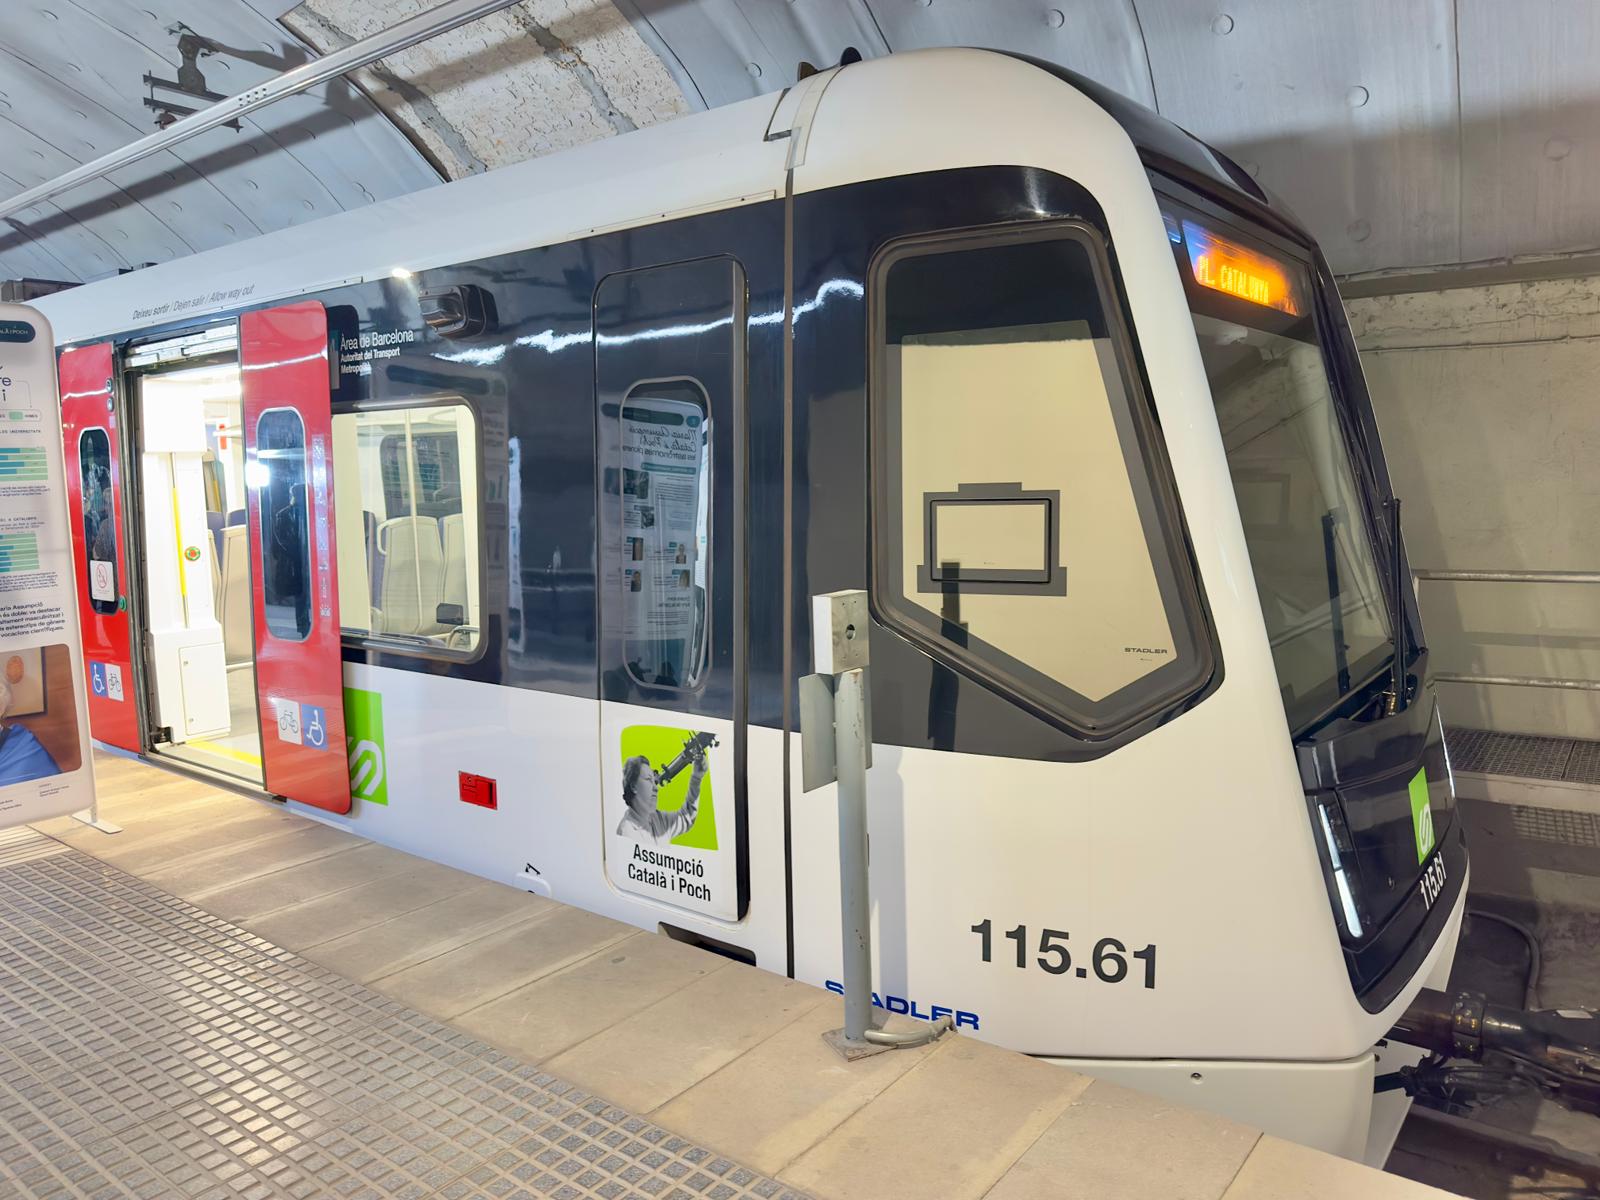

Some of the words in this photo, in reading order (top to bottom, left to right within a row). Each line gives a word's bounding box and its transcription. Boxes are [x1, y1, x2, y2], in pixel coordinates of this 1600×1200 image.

[132, 309, 152, 320] Deixeu
[153, 303, 170, 316] sortir
[174, 300, 192, 312] Dejen
[191, 296, 205, 307] salir
[210, 291, 228, 303] Allow
[227, 289, 241, 300] way
[241, 284, 255, 296] out
[340, 332, 359, 351] Àrea
[360, 335, 370, 348] de
[371, 328, 415, 347] Barcelona
[340, 350, 364, 363] Autoritat
[364, 349, 373, 360] del
[373, 346, 401, 360] Transport
[633, 843, 704, 878] Assumpció
[628, 863, 667, 889] Català
[670, 875, 675, 891] i
[679, 877, 711, 902] Poch
[1419, 850, 1447, 911] 115.61
[971, 918, 1157, 990] 115.61
